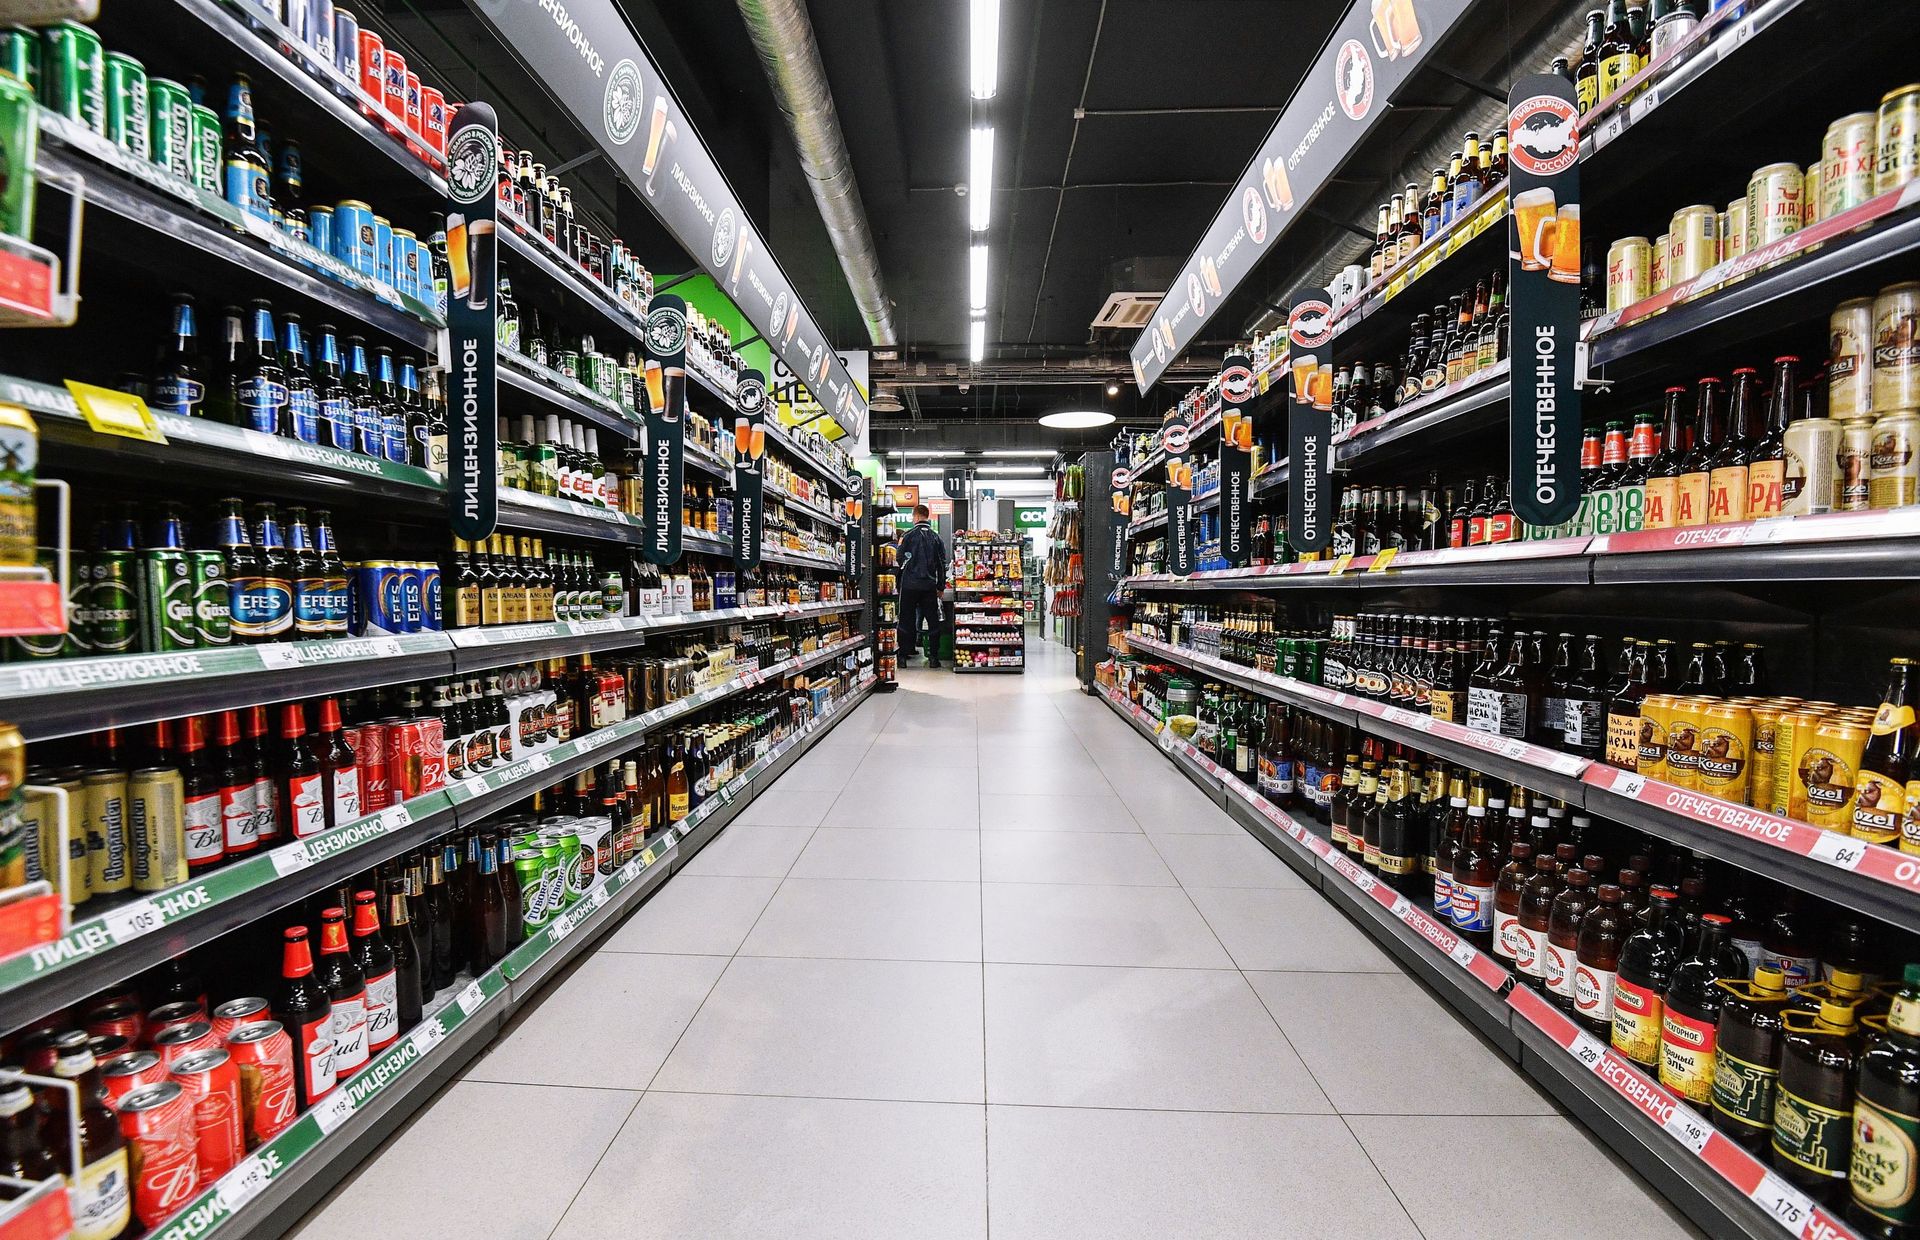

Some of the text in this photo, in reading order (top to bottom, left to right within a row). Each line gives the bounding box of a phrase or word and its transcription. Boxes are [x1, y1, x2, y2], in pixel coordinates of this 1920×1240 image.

[1735, 27, 1747, 41] 79
[1514, 99, 1565, 122] ПИВОВАРНИ
[1644, 95, 1654, 108] 79
[1288, 100, 1336, 171] ОТЕЧЕСТВЕННОЕ
[1608, 124, 1617, 137] 79
[1533, 150, 1574, 171] РОССИИ
[1535, 325, 1556, 504] ОТЕЧЕСТВЕННОЕ
[463, 338, 481, 520] ЛИЦЕНЗИОННОЕ
[656, 439, 670, 553] ЛИЦЕНЗИОННОЕ
[948, 477, 960, 491] 11
[1303, 435, 1317, 541] ОТЕЧЕСТВЕННОЕ
[1230, 471, 1240, 553] ОТЕЧЕСТВЕННОЕ
[741, 497, 752, 560] ИМПОРТНОЕ
[1176, 505, 1186, 569] ОТЕЧЕСТВЕННОЕ
[407, 585, 420, 623] EFES
[293, 642, 376, 664] ЦЕНЗИОНН
[17, 655, 204, 690] ЛИЦЕНЗИОННОЕ
[1698, 756, 1738, 773] Kozel
[1625, 782, 1638, 793] 64
[1666, 791, 1794, 843] ОТЕЧЕСТВЕННОЕ
[101, 797, 127, 882] Hoegaarden
[1836, 848, 1855, 864] 64
[527, 879, 549, 922] TUBORG
[128, 912, 154, 933] 105
[1582, 1046, 1598, 1063] 229
[1685, 1123, 1701, 1139] 149
[1775, 1197, 1799, 1223] 175
